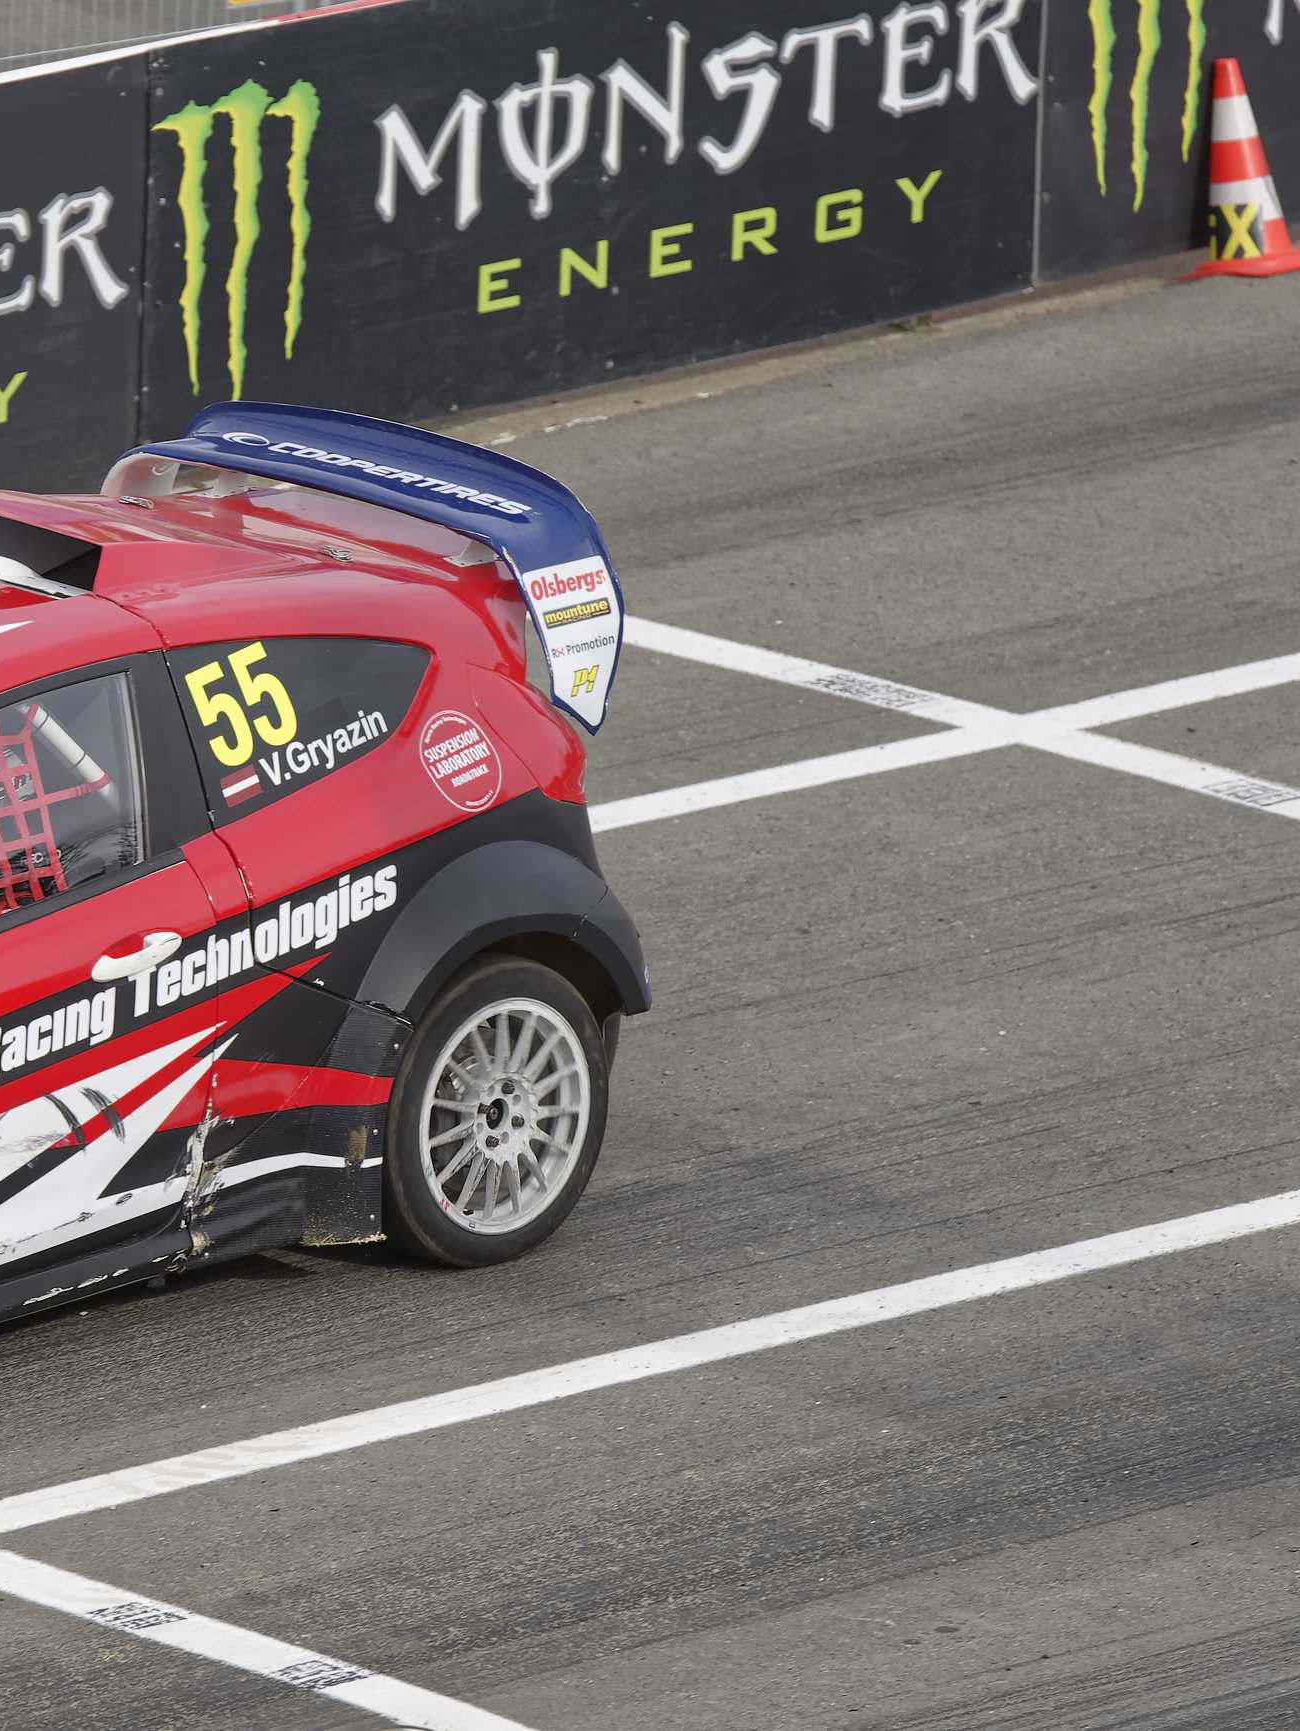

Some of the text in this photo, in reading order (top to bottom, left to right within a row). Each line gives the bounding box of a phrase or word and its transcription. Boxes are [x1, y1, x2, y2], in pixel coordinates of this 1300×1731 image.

[373, 0, 1039, 231] MONSTER
[478, 170, 943, 313] ENERGY
[530, 568, 605, 601] Olsbergs
[544, 600, 608, 624] mountune
[566, 634, 615, 656] Promotion
[184, 641, 298, 767] 55
[258, 709, 389, 787] V.Gryazin
[424, 727, 480, 763] SUSPENSION
[429, 741, 491, 780] LABORATORY
[128, 863, 398, 1018] Technologies
